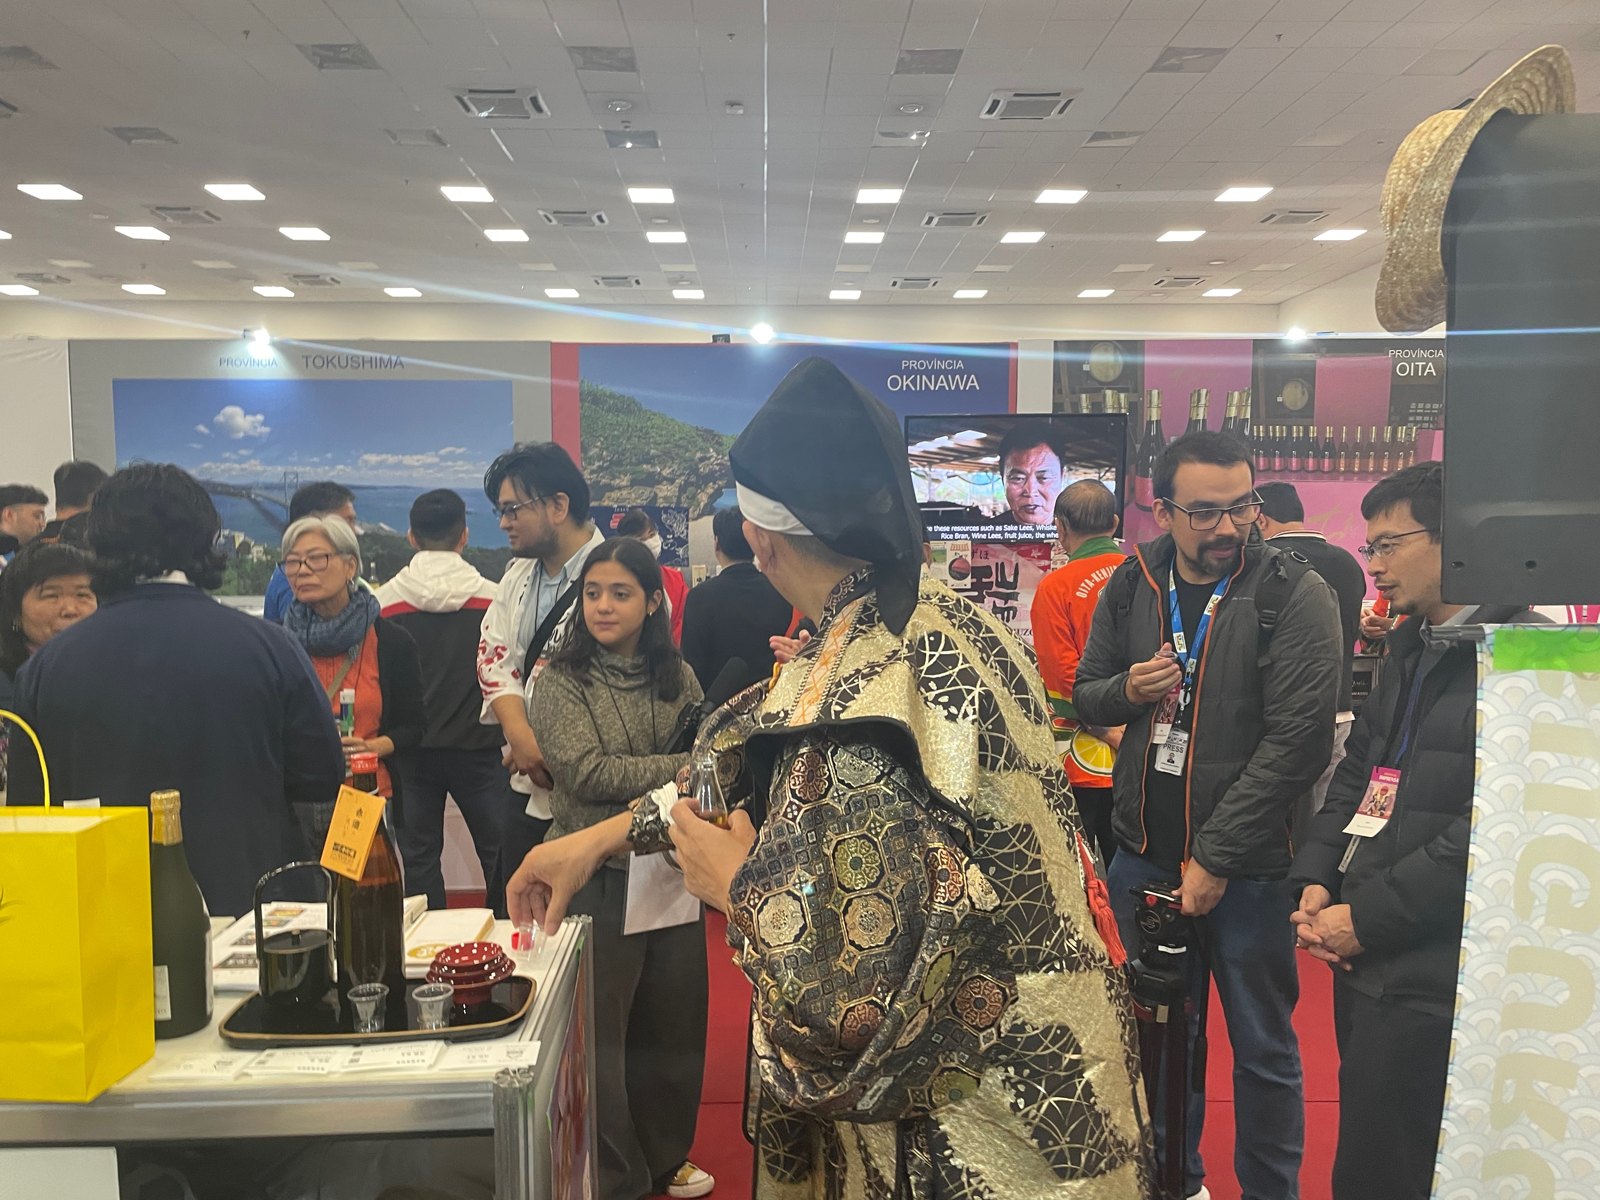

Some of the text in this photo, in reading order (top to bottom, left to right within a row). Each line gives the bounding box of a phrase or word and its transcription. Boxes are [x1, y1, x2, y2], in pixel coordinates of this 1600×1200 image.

[1388, 348, 1445, 358] PROVÍNCIA
[219, 354, 405, 370] PROVÍNCIA TOKUSHIMA
[901, 357, 964, 370] PROVÍNCIA
[1396, 362, 1437, 377] OITA
[886, 374, 980, 391] OKINAWA
[1162, 743, 1185, 754] PRESS
